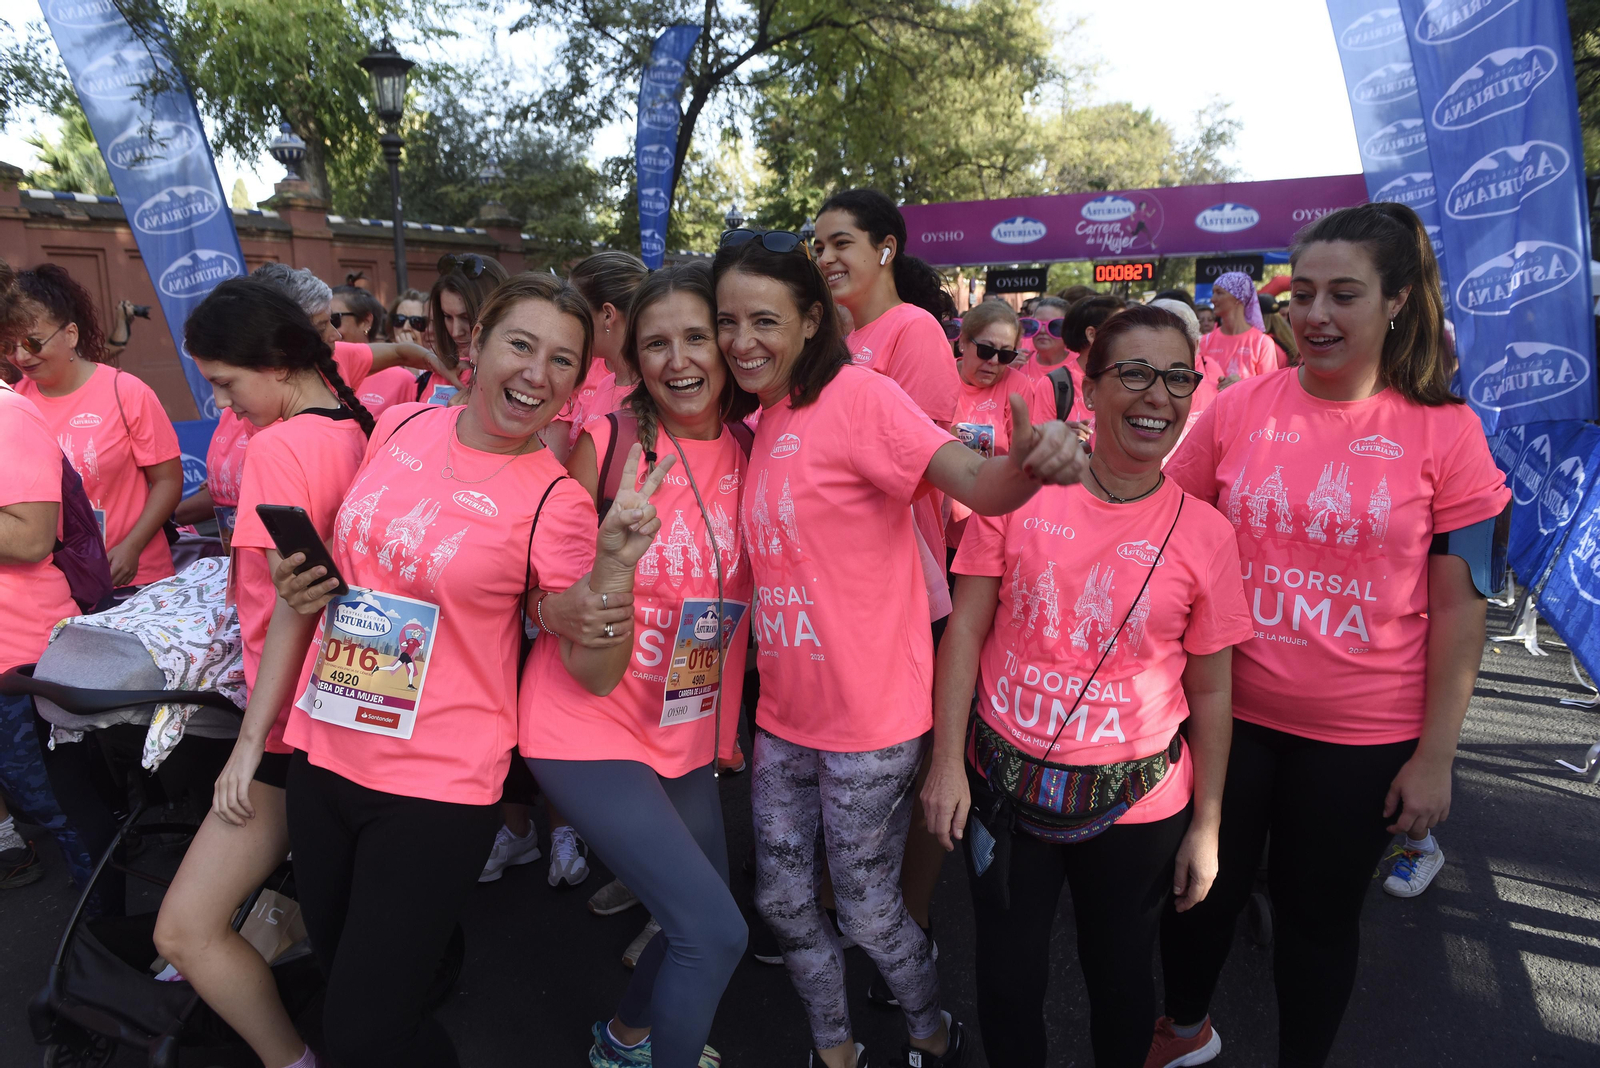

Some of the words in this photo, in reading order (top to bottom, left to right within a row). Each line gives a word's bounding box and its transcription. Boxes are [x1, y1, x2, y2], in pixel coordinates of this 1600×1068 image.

[1086, 205, 1132, 217] ASTURIANA
[1200, 212, 1255, 227] ASTURIANA
[995, 227, 1043, 239] ASTURIANA
[1075, 220, 1122, 235] Carrera
[922, 230, 964, 243] OYSHO
[1101, 231, 1138, 254] Mujer
[1095, 263, 1153, 282] 000827
[996, 276, 1039, 289] OYSHO
[1353, 442, 1399, 457] ASTURIANA
[455, 493, 493, 516] ASTURIANA
[1023, 517, 1076, 540] OYSHO
[1264, 564, 1377, 601] DORSAL
[335, 608, 386, 633] ASTURIANA
[641, 606, 673, 629] TU
[1253, 588, 1370, 642] UMA
[1266, 633, 1277, 641] LA
[1278, 635, 1308, 647] MUJER
[324, 638, 380, 672] 016
[688, 647, 715, 670] 016
[330, 670, 360, 687] 4920
[632, 670, 668, 684] CARRERA
[1004, 650, 1019, 677] TU
[1023, 664, 1131, 703] DORSAL
[334, 686, 345, 695] DE
[345, 688, 355, 698] LA
[357, 691, 384, 704] MUJER
[678, 688, 694, 698] CARRERA
[667, 705, 688, 718] OYSHO
[990, 675, 1126, 744] SUMA
[368, 713, 394, 724] Santander
[1011, 728, 1022, 739] DE
[1022, 733, 1031, 743] LA
